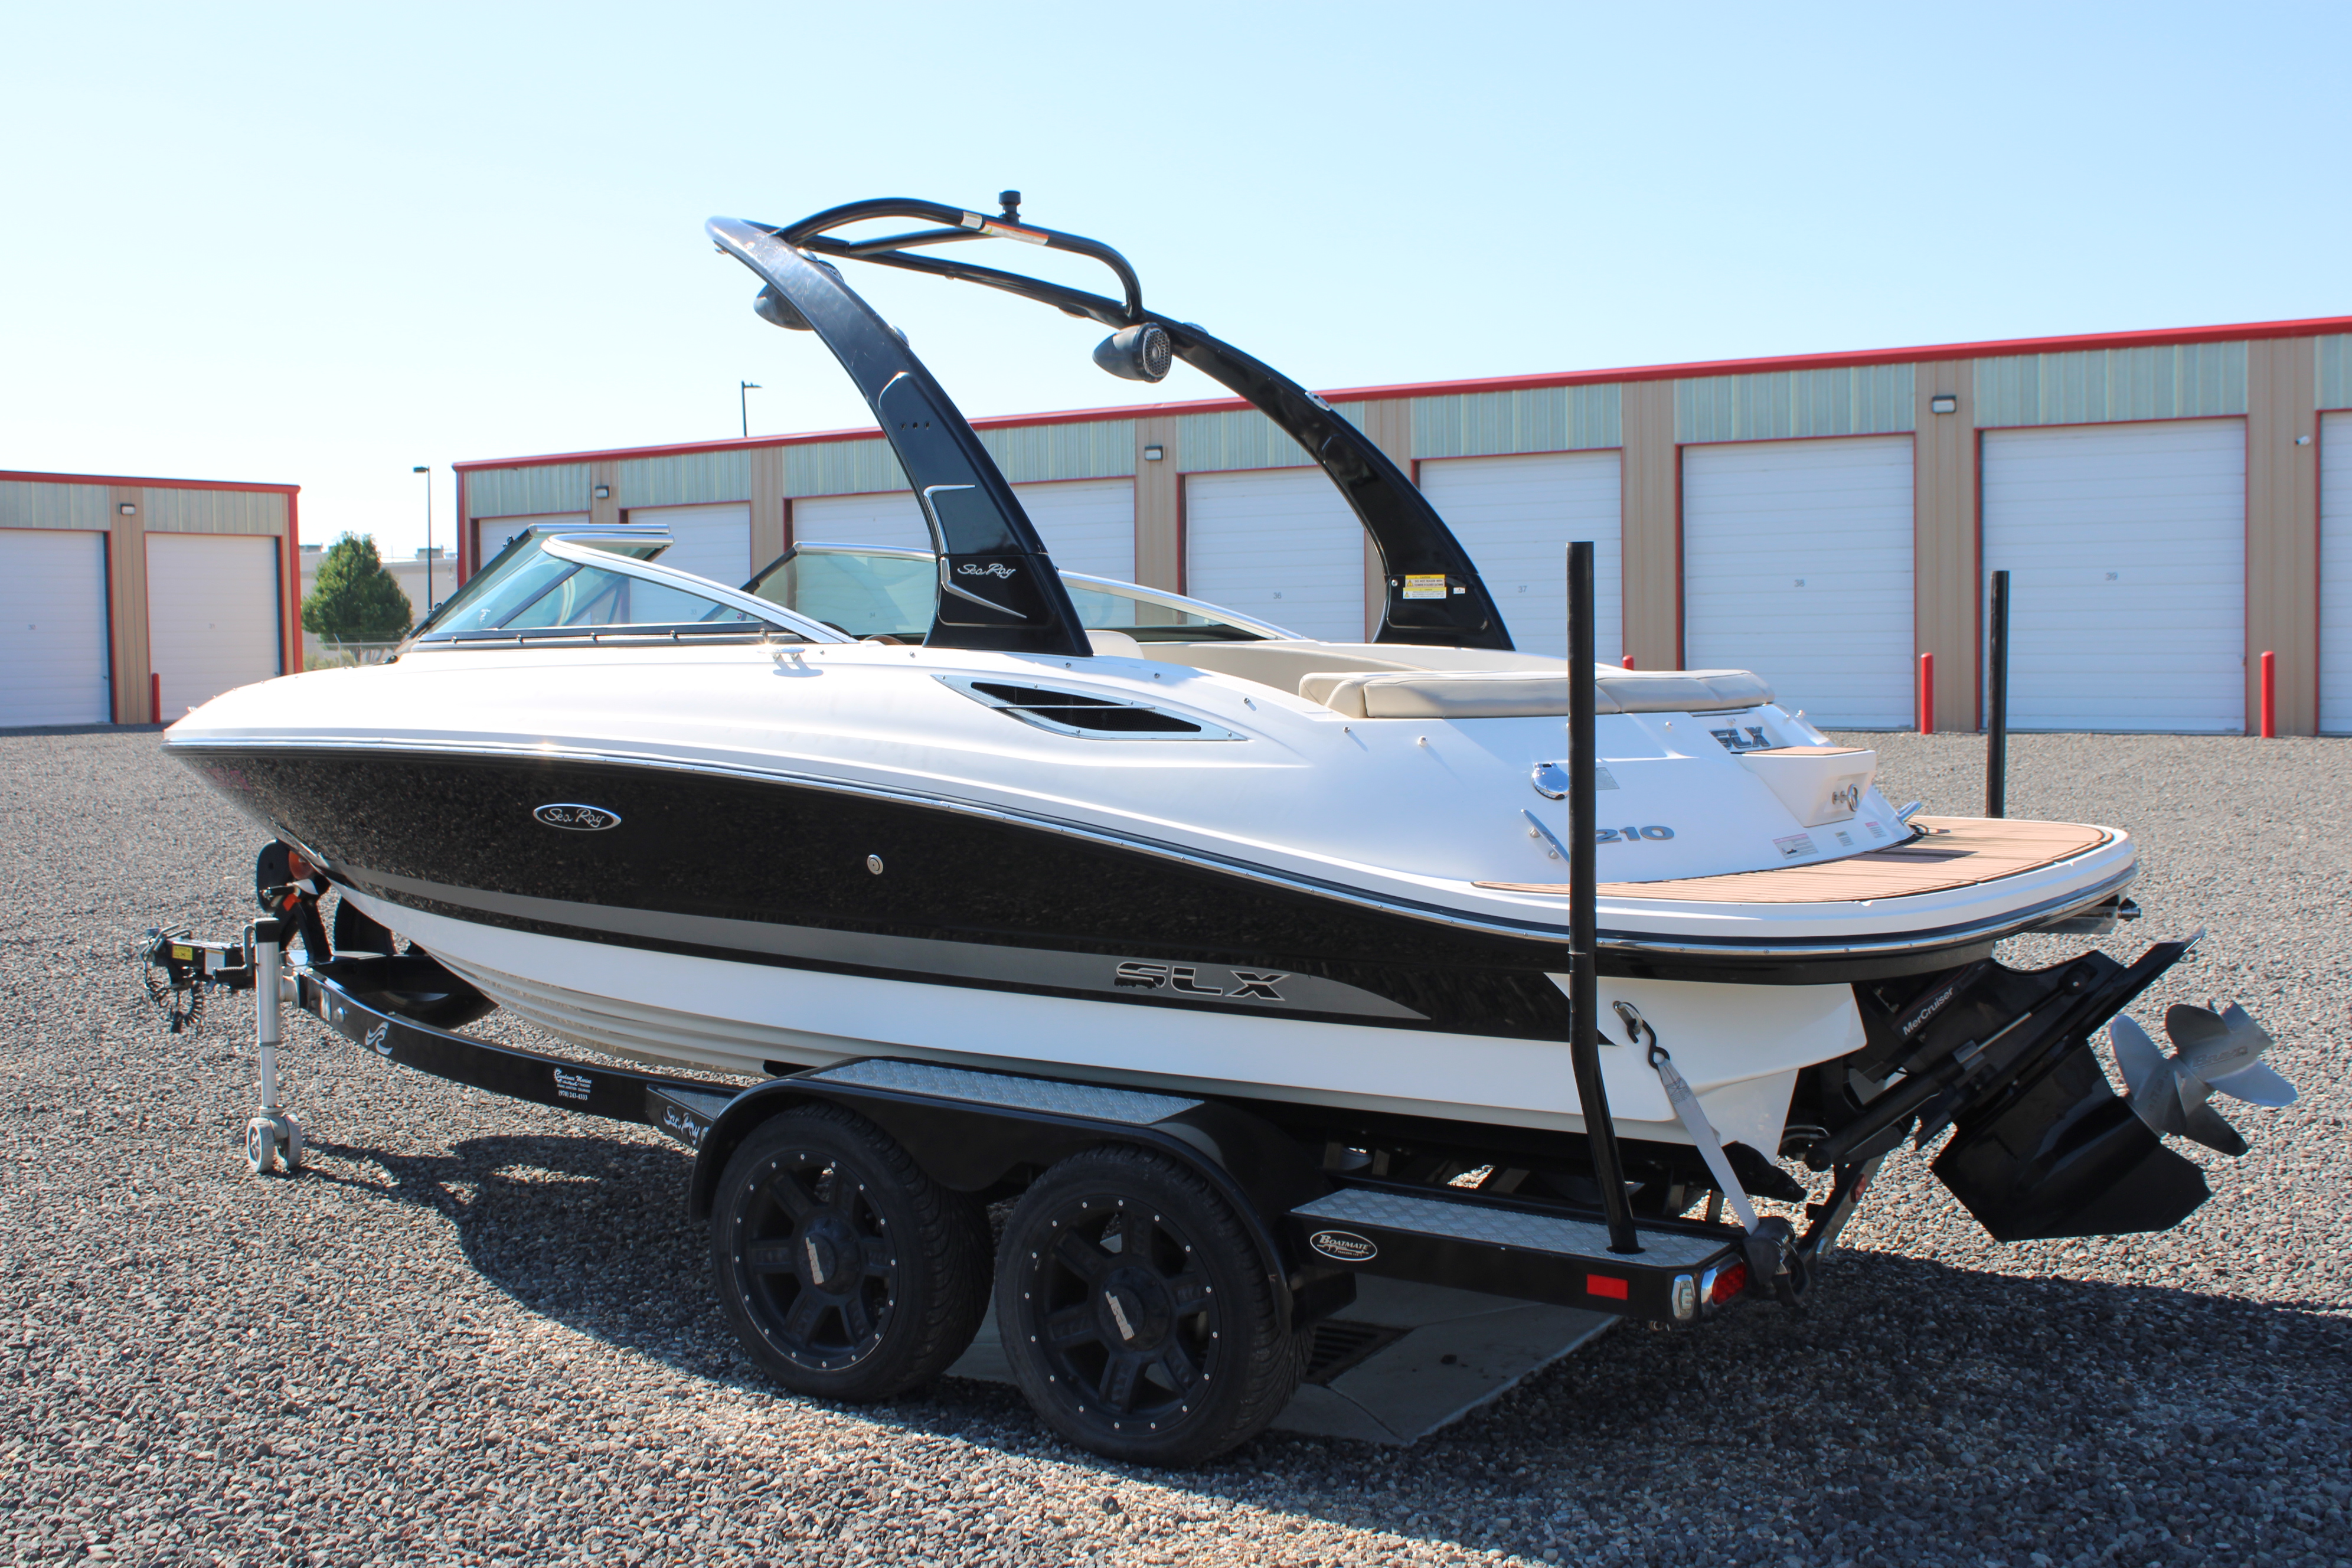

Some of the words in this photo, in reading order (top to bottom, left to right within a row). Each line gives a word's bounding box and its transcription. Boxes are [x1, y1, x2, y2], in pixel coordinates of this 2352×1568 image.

[957, 564, 986, 576] Sea
[988, 563, 1016, 579] Ray
[544, 808, 573, 822] Sea
[575, 808, 605, 828] Ray
[1596, 825, 1675, 844] 210
[1114, 961, 1291, 1001] SLX
[1902, 987, 1954, 1035] MerCruiser
[569, 1092, 588, 1100] 243-4333
[663, 1106, 682, 1130] Sea
[681, 1112, 700, 1145] Ray
[1319, 1234, 1368, 1250] BOATMATE
